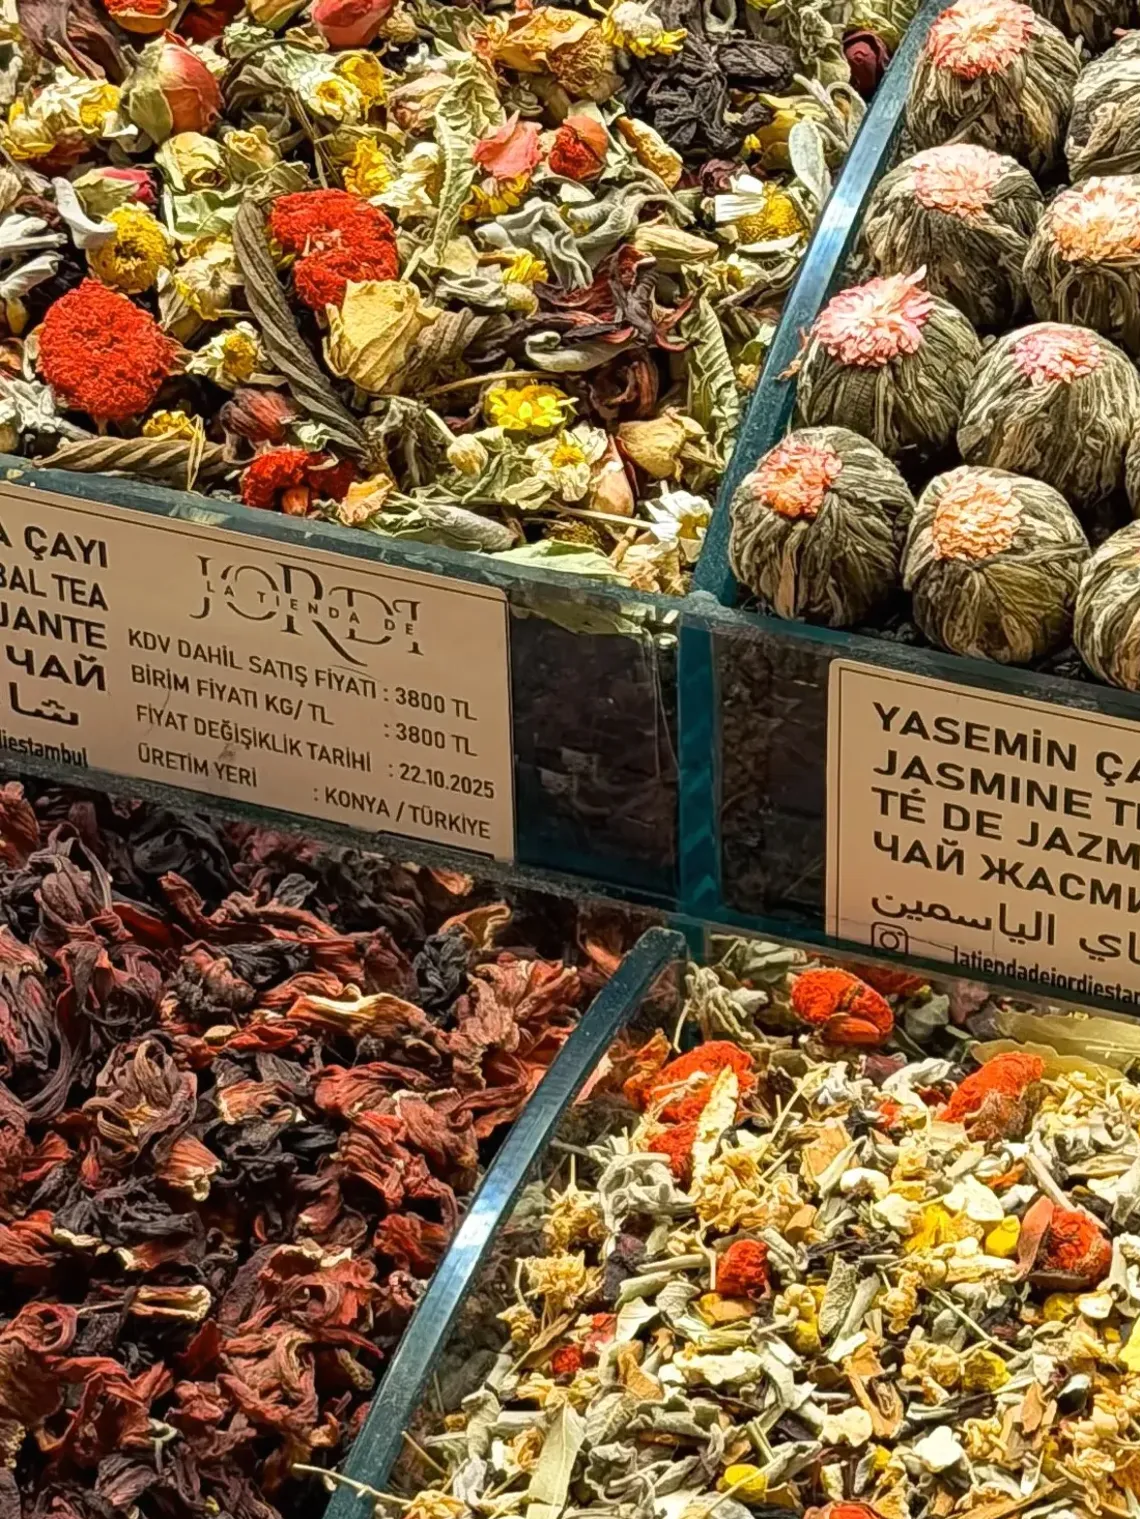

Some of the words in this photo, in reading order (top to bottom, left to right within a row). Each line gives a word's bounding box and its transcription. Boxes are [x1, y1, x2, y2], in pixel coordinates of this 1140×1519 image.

[24, 525, 107, 568] ÇAYI
[52, 574, 108, 611] TEA
[257, 590, 360, 624] TIENDA
[384, 618, 414, 635] DE
[6, 645, 106, 691] ЧАЙ
[128, 628, 170, 654] KDV
[179, 639, 242, 670] DAHİL
[250, 656, 307, 687] SATIŞ
[315, 668, 376, 699] FİYATI
[451, 699, 477, 721] TL
[131, 662, 189, 693] BİRİM
[197, 678, 257, 709] FİYATI
[266, 694, 303, 721] KG/
[308, 703, 334, 725] TL
[451, 734, 477, 756] TL
[136, 704, 187, 732] FİYAT
[195, 717, 302, 757] DEĞİŞİKLİK
[307, 741, 371, 772] TARİHİ
[400, 763, 494, 799] 22.10.2025
[872, 702, 1076, 772] YASEMİN
[138, 743, 208, 777] ÜRETİM
[215, 761, 257, 787] YERİ
[325, 786, 390, 817] KONYA
[409, 805, 491, 839] TÜRKİYE
[873, 750, 1092, 820] JASMINE
[871, 787, 926, 824] TÉ
[943, 802, 1002, 841] DE
[873, 831, 964, 876] ЧАЙ
[872, 894, 1056, 945] الياسمين
